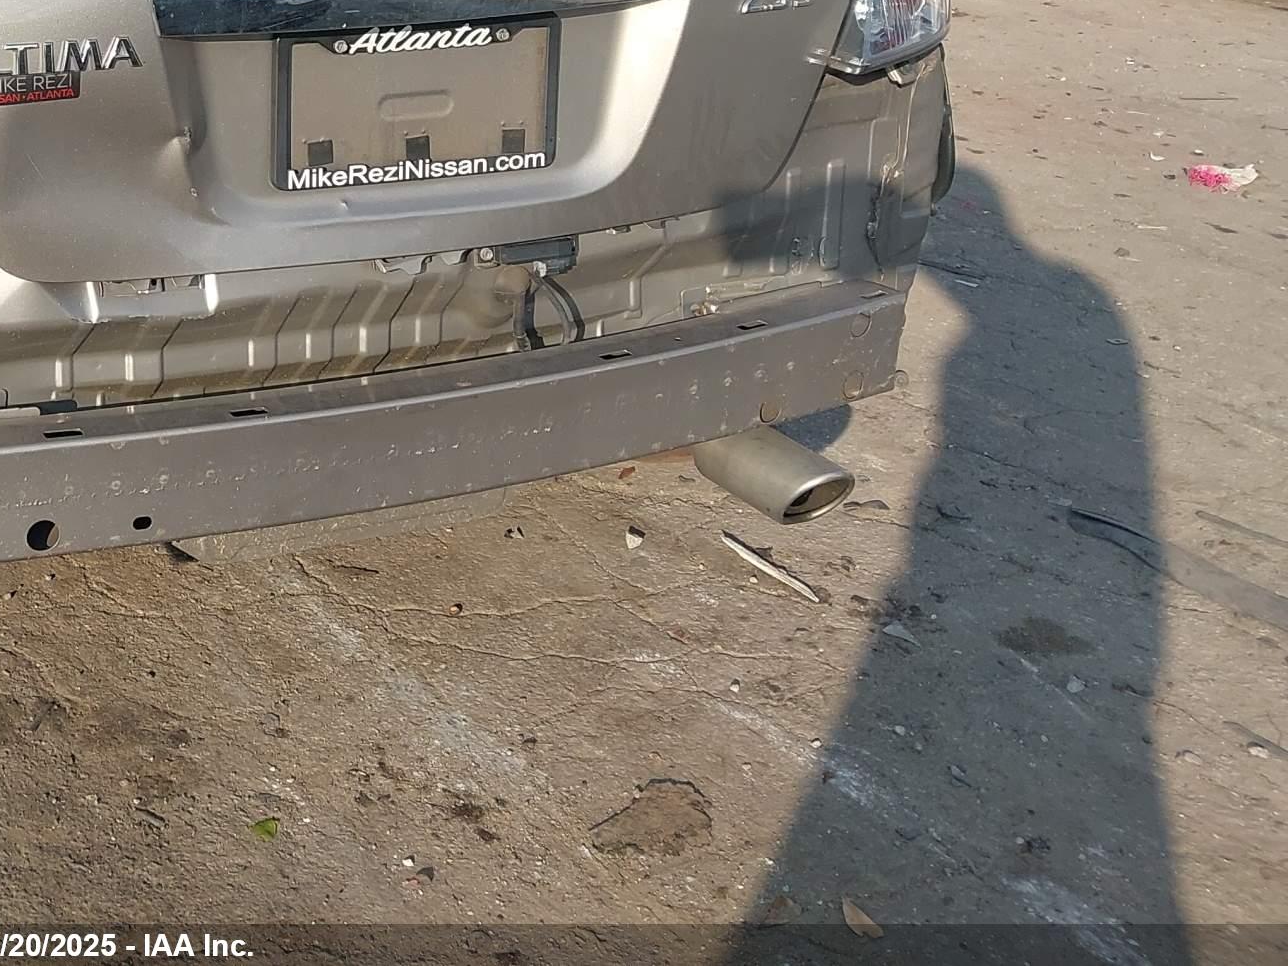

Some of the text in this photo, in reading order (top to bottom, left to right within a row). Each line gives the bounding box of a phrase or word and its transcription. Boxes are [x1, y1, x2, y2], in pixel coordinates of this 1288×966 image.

[349, 22, 493, 55] Atlanta
[33, 75, 73, 90] REZI
[287, 151, 546, 190] MikeReziNissan.com
